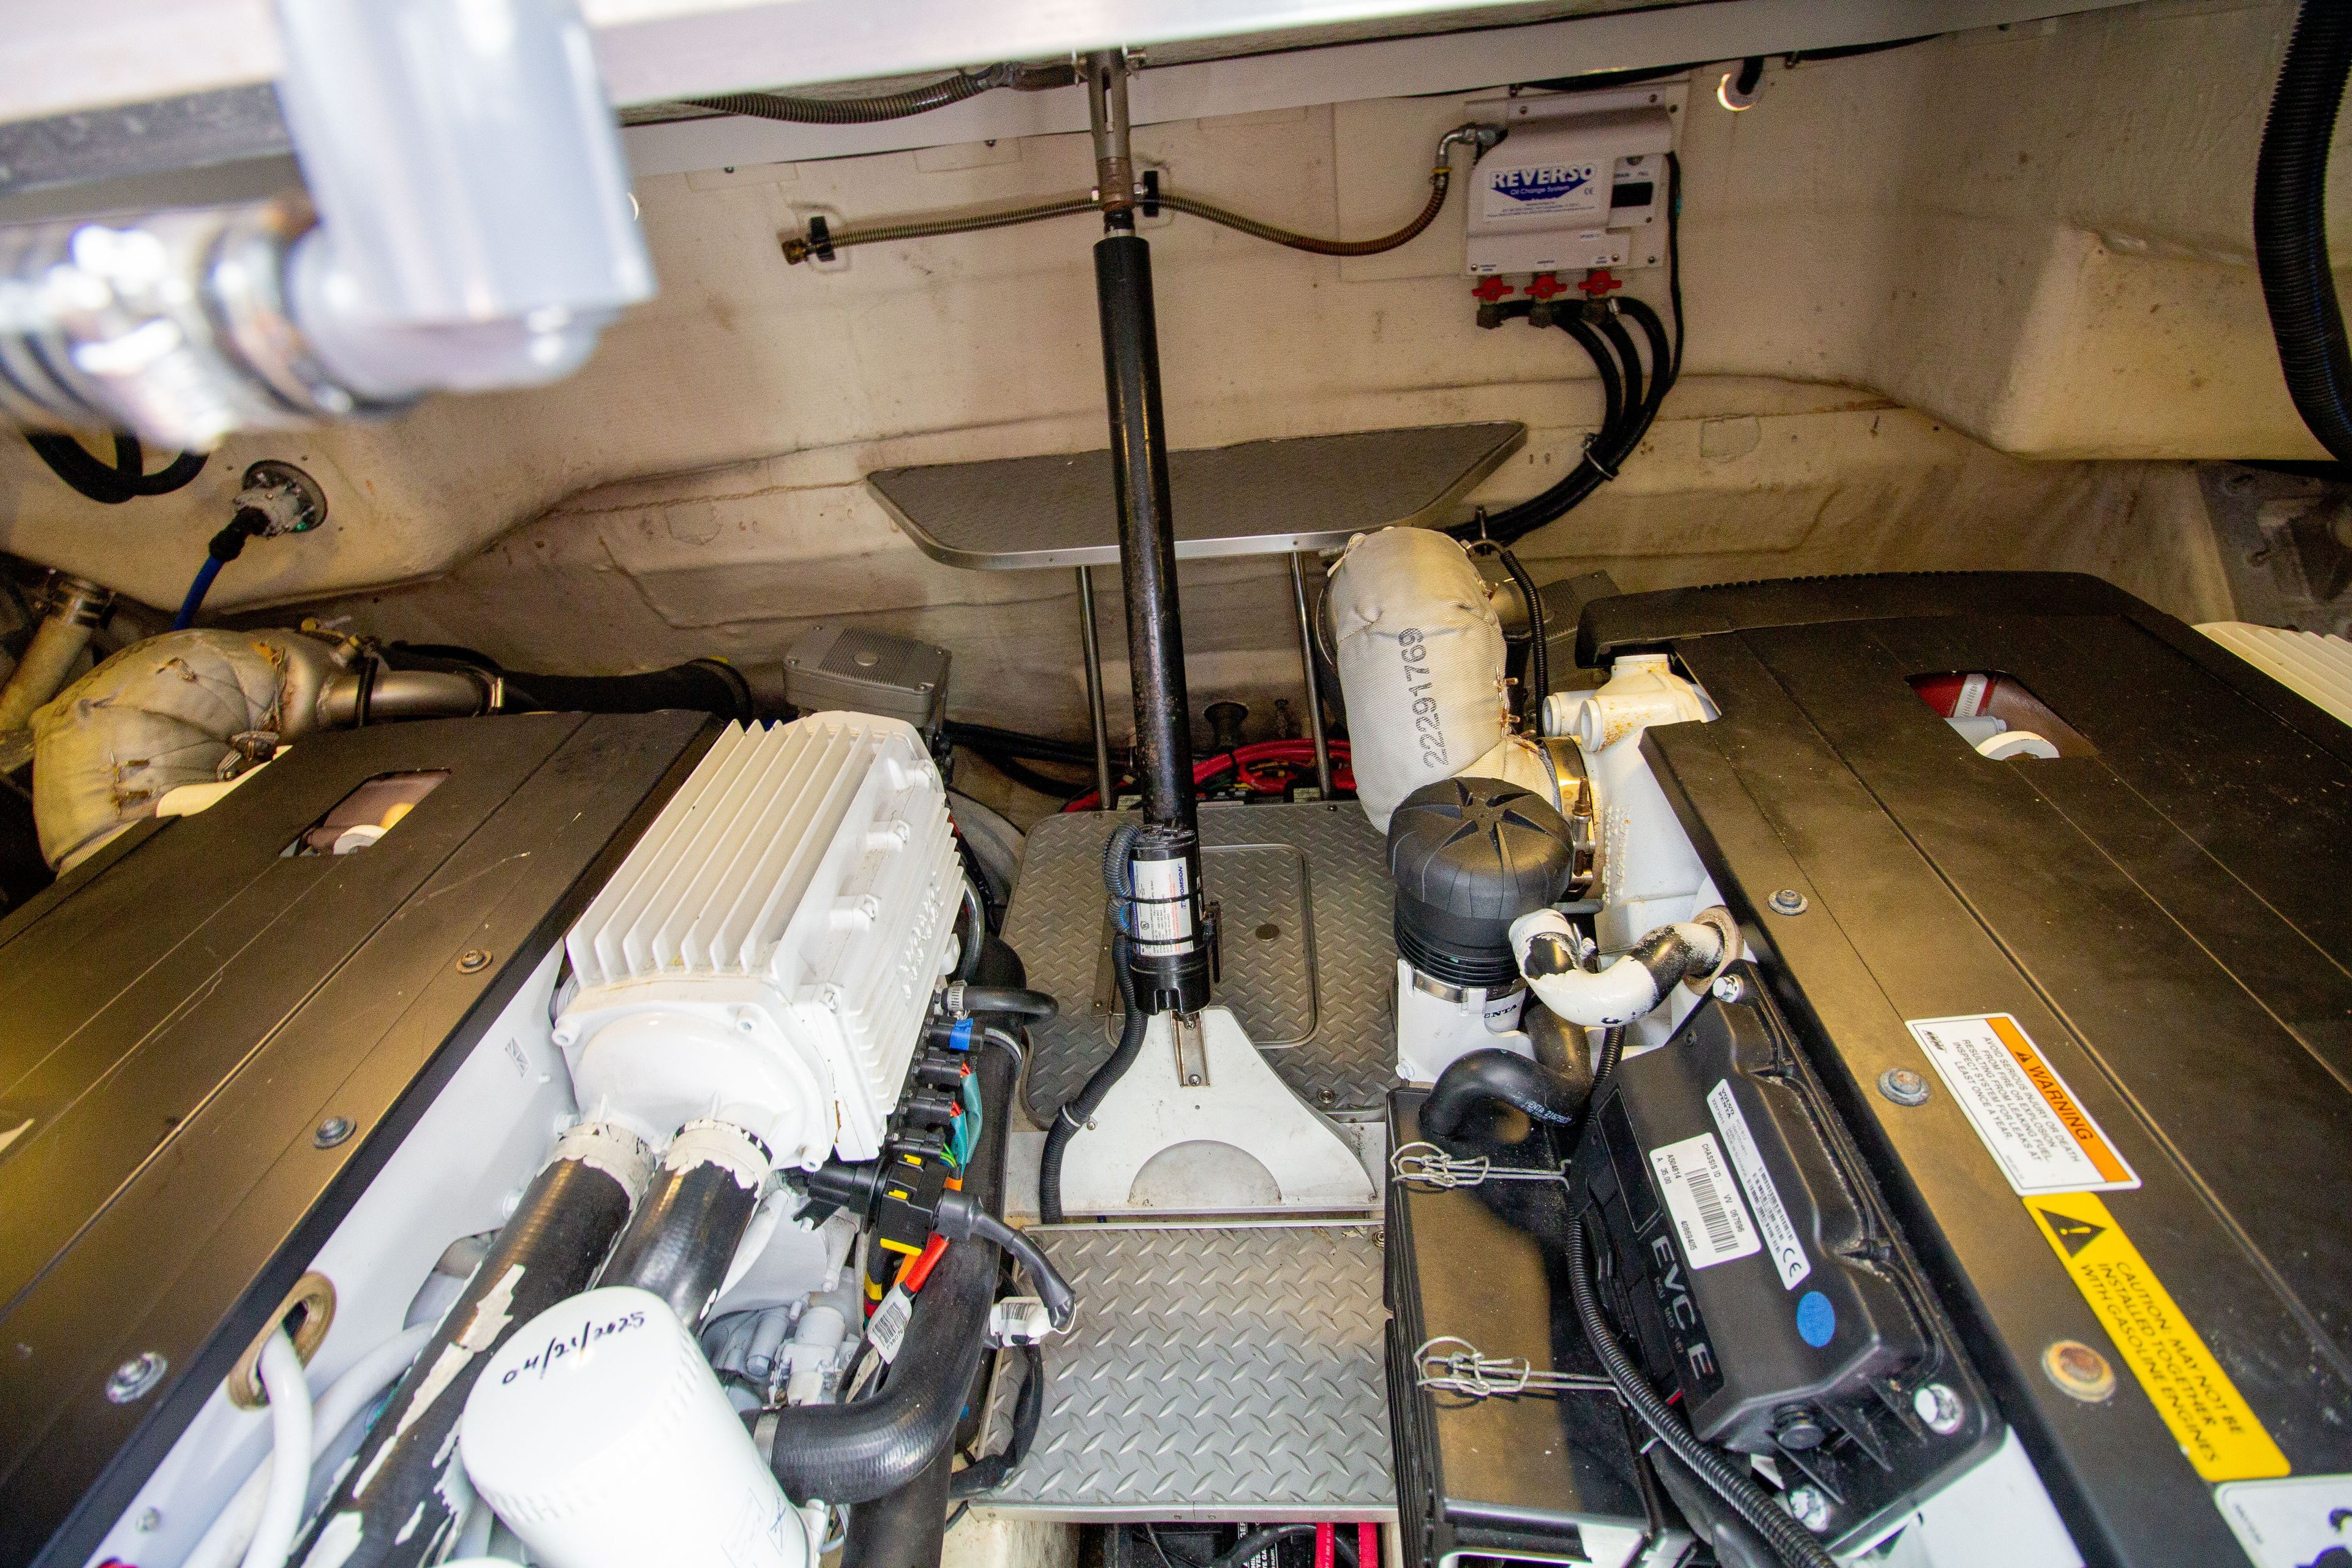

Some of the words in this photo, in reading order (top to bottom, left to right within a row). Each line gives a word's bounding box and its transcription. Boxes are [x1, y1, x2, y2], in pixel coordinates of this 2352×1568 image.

[1490, 165, 1594, 189] REVERSO
[1398, 627, 1449, 768] 22291769
[1483, 1003, 1518, 1020] ENTA
[1718, 1091, 1732, 1118] PENTA
[1721, 1088, 1735, 1115] VOLVO
[1953, 1042, 1978, 1071] INSPECT
[1974, 1073, 2000, 1102] SYSTEM
[1997, 1104, 2013, 1120] FOR
[2008, 1122, 2033, 1149] LEAKS
[2029, 1151, 2041, 1160] AT
[1954, 1061, 1976, 1084] LEAST
[1972, 1086, 1991, 1107] ONCE
[1994, 1116, 2013, 1138] YEAR.
[1964, 1039, 1995, 1078] RESULTING
[1993, 1080, 2011, 1101] FROM
[2007, 1103, 2037, 1137] LEAKING
[1983, 1050, 2001, 1070] FROM
[1999, 1072, 2014, 1087] FIRE
[2010, 1090, 2024, 1101] OR
[2019, 1102, 2056, 1148] EXPLOSION
[1984, 1037, 2003, 1057] AVOID
[1999, 1059, 2028, 1091] SERIOUS
[2024, 1092, 2048, 1118] INJURY
[2045, 1121, 2059, 1133] OR
[2055, 1135, 2079, 1162] DEATH
[2029, 1066, 2094, 1140] WARNING
[1660, 1168, 1672, 1185] 35.00
[1667, 1154, 1681, 1179] A504814
[1702, 1144, 1718, 1170] CHASSIS
[1730, 1209, 1744, 1232] 067696
[1681, 1221, 1697, 1250] 40869405
[1651, 1235, 1695, 1330] EVC
[502, 1311, 645, 1385] 04/21/2025
[2081, 1264, 2111, 1301] WITH
[2106, 1304, 2166, 1381] GASOLINE
[2161, 1387, 2217, 1462] ENGINES
[2098, 1264, 2155, 1336] INSTALLED
[2154, 1341, 2217, 1425] TOGETHER
[2116, 1262, 2171, 1330] CAUTION:
[2173, 1339, 2198, 1370] MAY
[2196, 1375, 2228, 1409] NOT
[2222, 1415, 2242, 1432] BE
